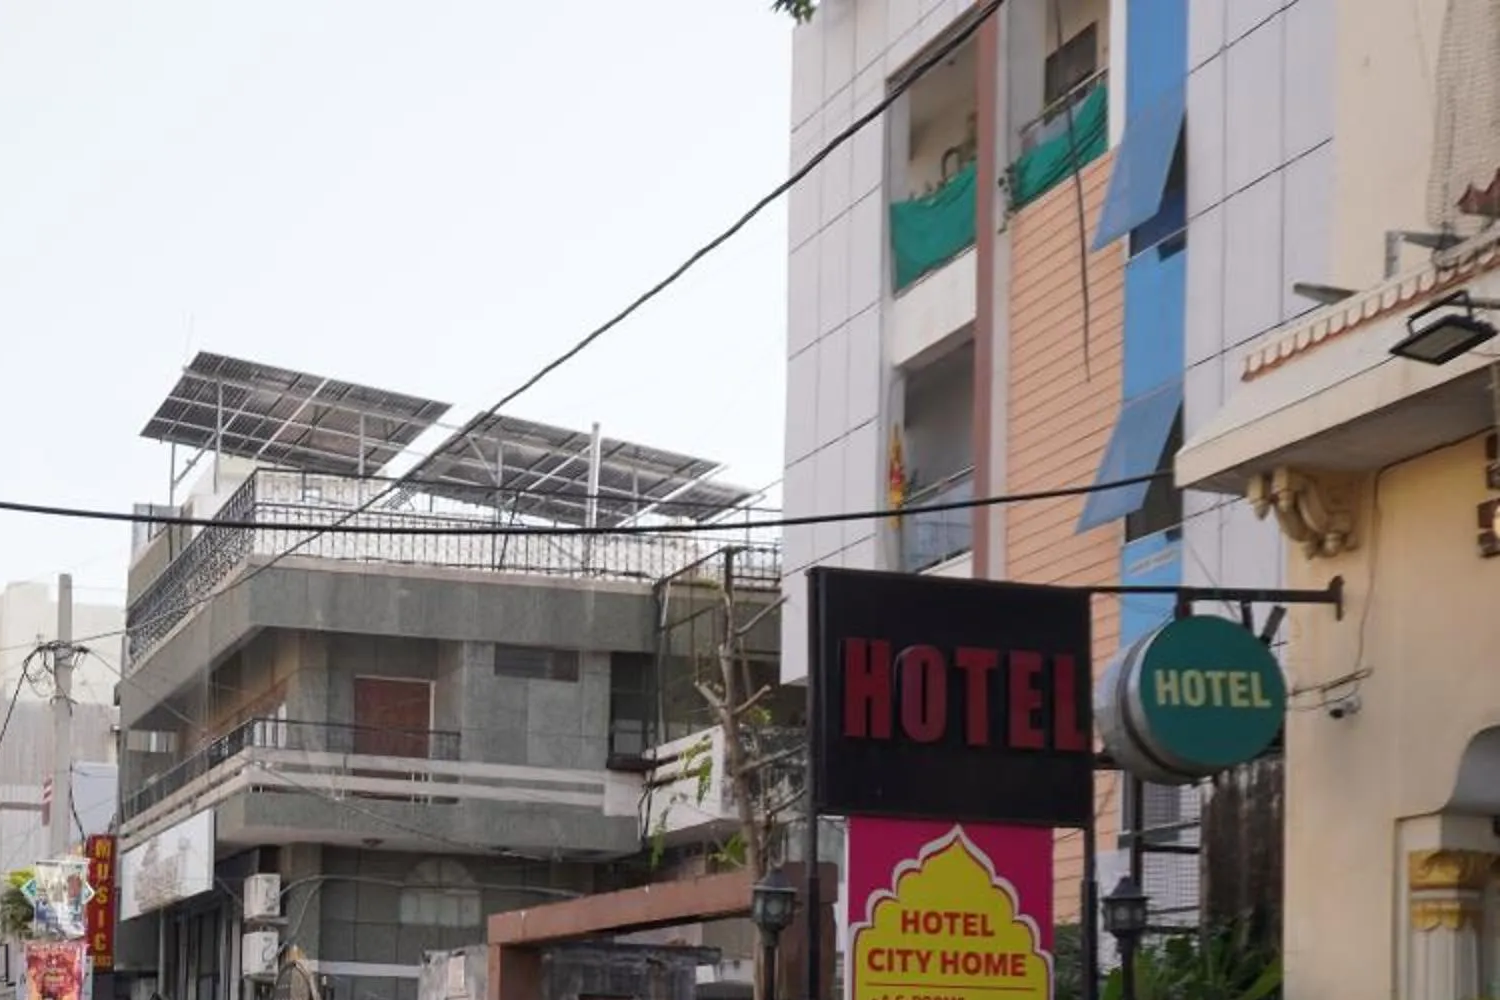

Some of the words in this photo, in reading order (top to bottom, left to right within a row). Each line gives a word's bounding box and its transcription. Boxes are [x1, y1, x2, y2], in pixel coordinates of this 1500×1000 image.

[844, 637, 1087, 751] HOTEL
[1155, 668, 1273, 708] HOTEL
[95, 838, 113, 951] MUSIC
[901, 910, 996, 938] HOTEL
[867, 948, 934, 974] CITY
[940, 951, 1028, 978] HOME
